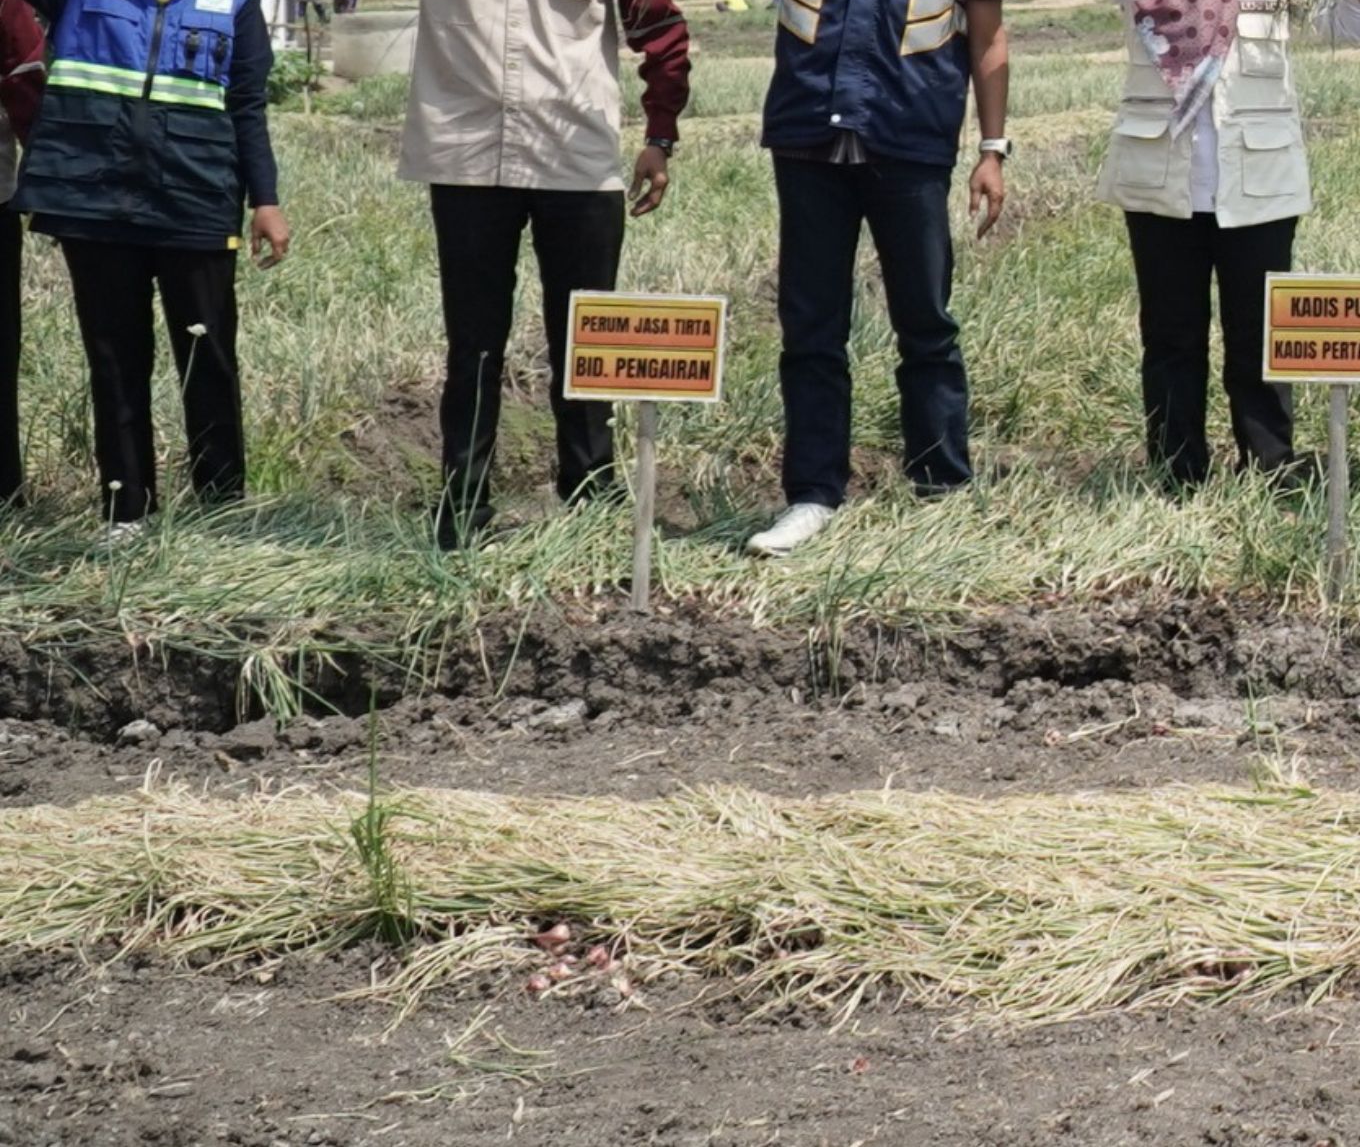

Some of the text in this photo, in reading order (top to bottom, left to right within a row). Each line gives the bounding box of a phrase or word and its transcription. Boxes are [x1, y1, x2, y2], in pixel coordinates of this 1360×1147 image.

[1290, 296, 1339, 318] KADIS
[580, 315, 711, 336] PERUM JASA TIRTA
[1274, 339, 1318, 360] KADIS
[575, 355, 711, 381] BID. PENGAIRAN
